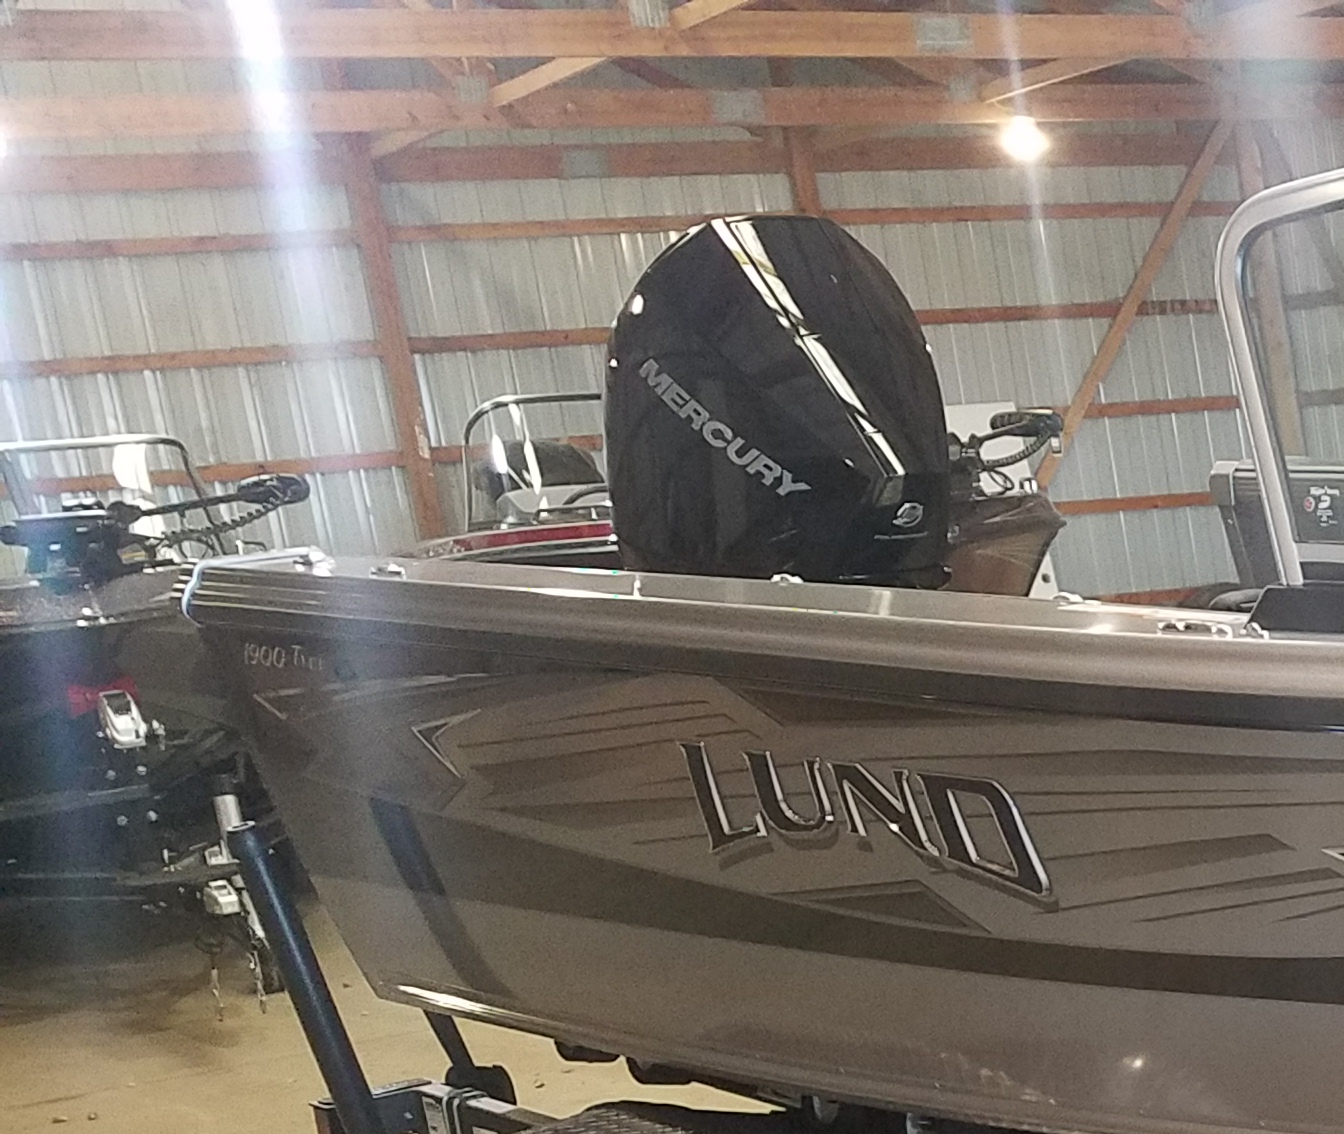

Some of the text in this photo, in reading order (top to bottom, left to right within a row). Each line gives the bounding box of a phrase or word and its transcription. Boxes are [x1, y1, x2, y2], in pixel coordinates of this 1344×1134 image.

[639, 358, 812, 496] MERCURY
[244, 643, 286, 668] 1900
[677, 742, 1053, 898] LUND
